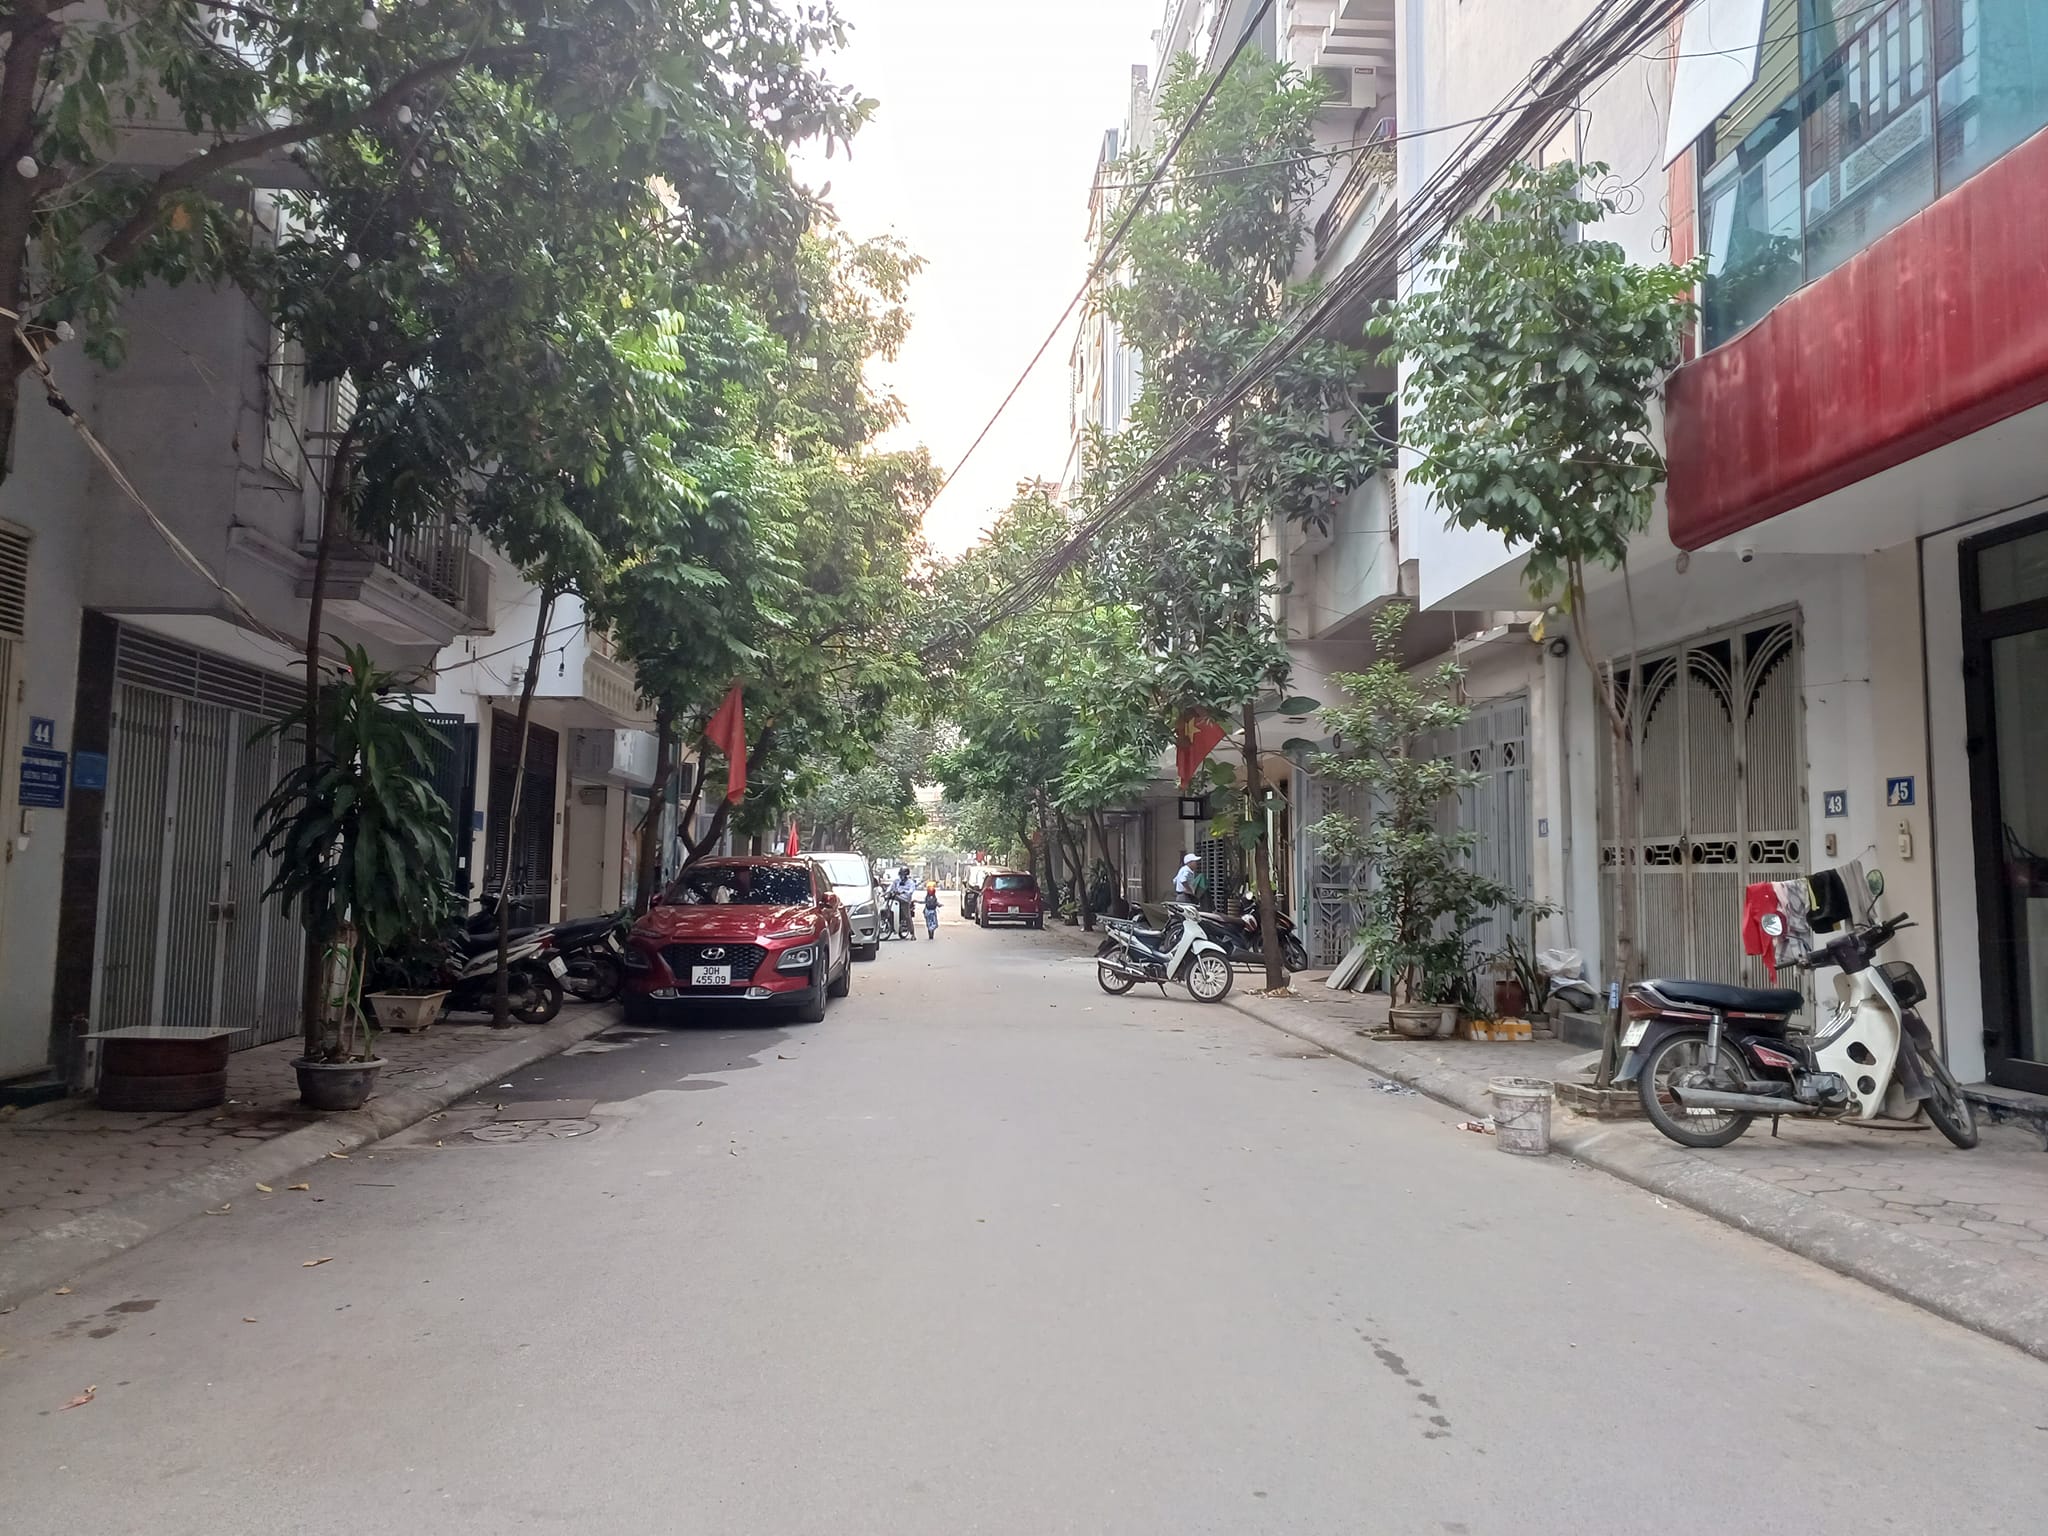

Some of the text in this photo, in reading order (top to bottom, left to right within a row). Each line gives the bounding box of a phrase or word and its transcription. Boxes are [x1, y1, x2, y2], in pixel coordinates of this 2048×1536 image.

[34, 723, 50, 743] 44
[1828, 796, 1842, 813] 43
[703, 966, 720, 975] 30H
[695, 975, 727, 985] 455.09
